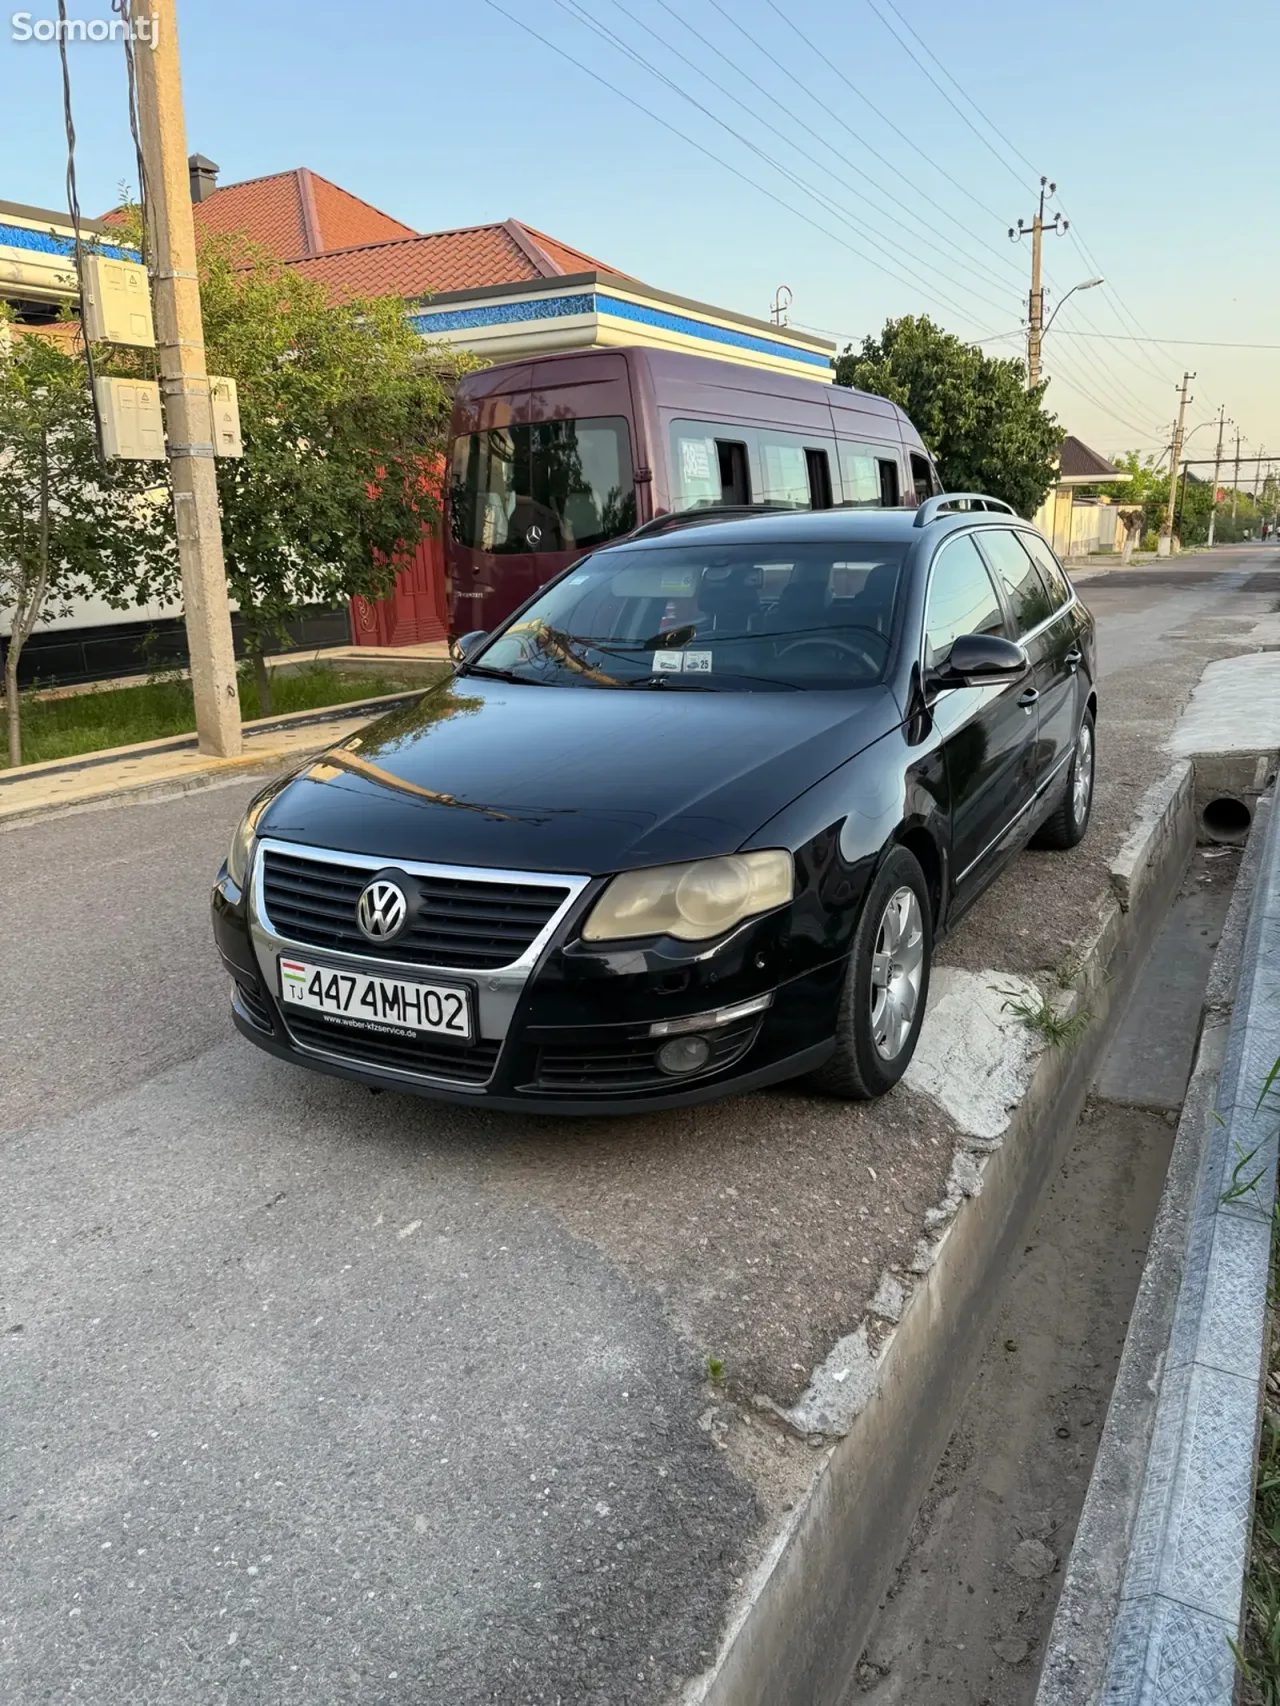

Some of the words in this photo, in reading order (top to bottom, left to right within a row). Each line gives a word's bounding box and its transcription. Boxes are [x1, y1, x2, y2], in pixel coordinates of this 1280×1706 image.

[289, 984, 304, 1001] TJ
[308, 970, 464, 1032] 4474MH02
[322, 1014, 418, 1039] www.weber-kfzservice.de
